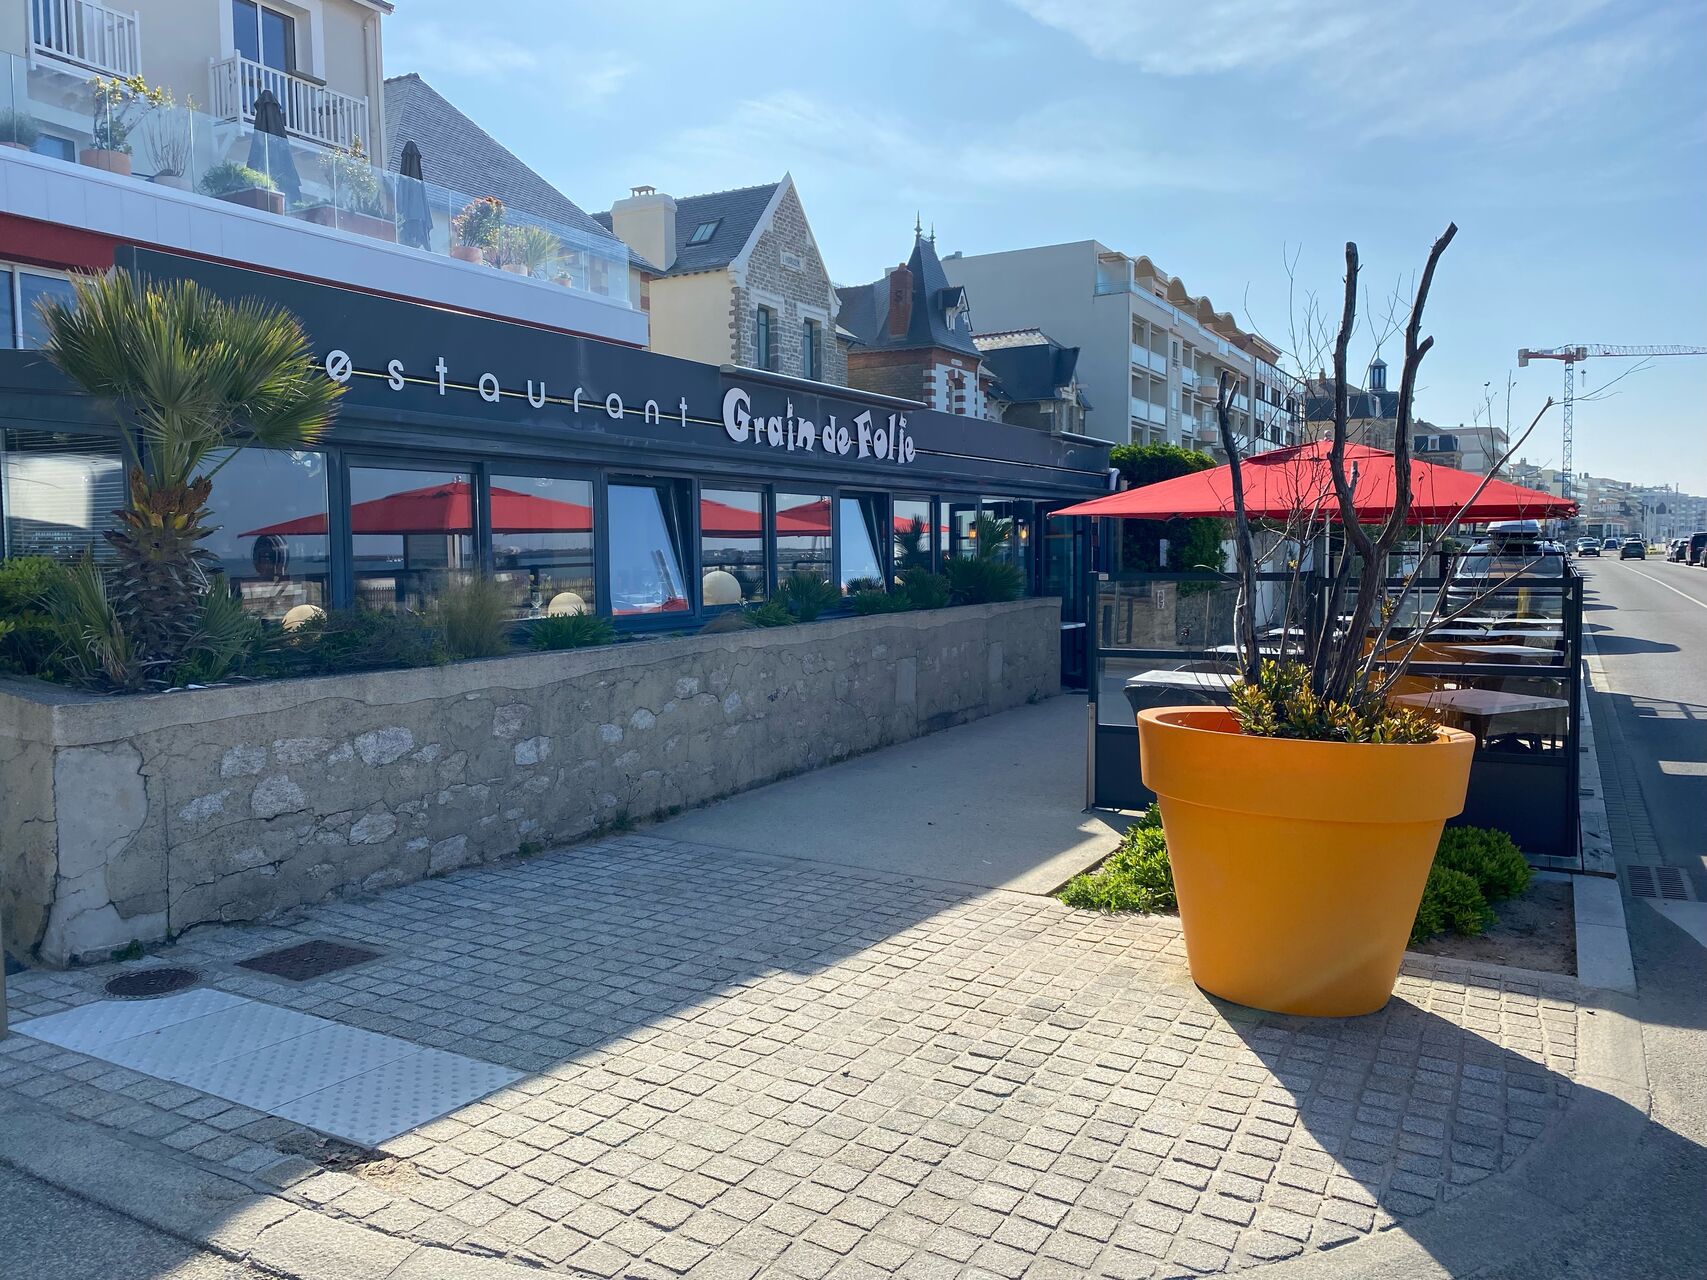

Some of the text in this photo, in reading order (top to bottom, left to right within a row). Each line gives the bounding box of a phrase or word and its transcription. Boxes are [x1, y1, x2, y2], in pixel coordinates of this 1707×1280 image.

[325, 349, 688, 428] estaurant
[722, 387, 917, 464] Grain de Folie
